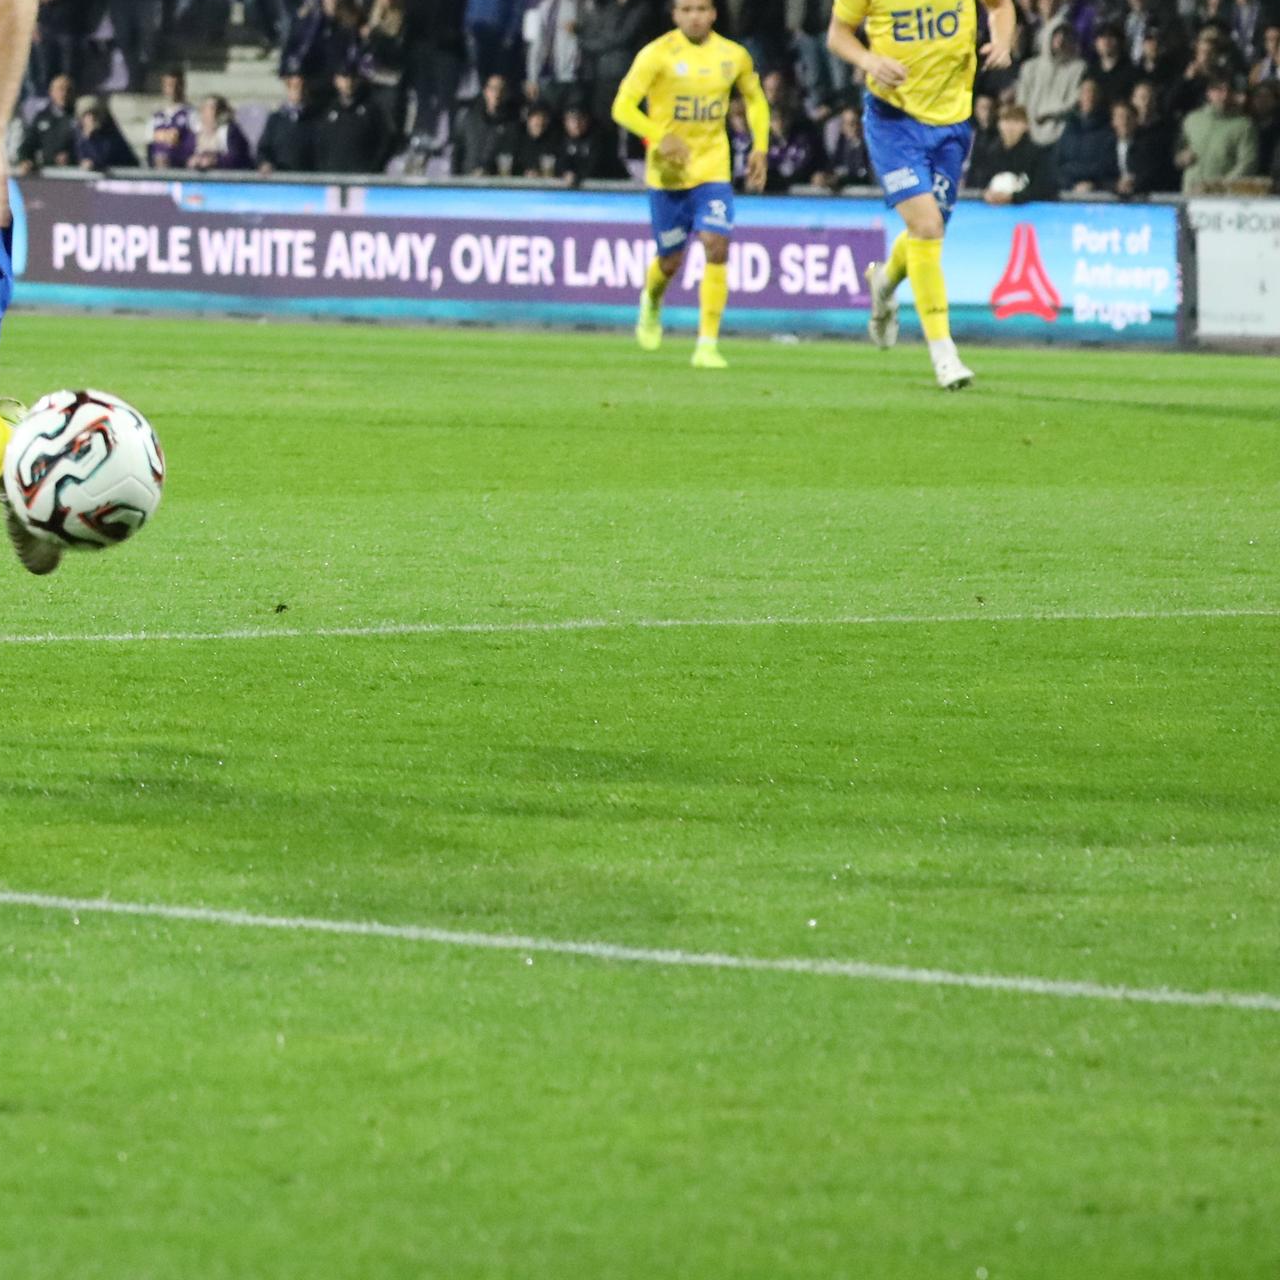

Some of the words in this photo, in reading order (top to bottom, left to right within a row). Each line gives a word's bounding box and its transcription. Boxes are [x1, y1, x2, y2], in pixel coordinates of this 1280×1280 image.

[891, 6, 959, 42] Elio
[1072, 223, 1122, 254] Port
[1125, 223, 1152, 255] of
[52, 222, 191, 274] PURPLE
[198, 226, 317, 278] WHITE
[323, 230, 443, 291] ARMY,
[450, 233, 555, 286] OVER
[779, 243, 861, 295] SEA
[1073, 259, 1170, 295] Antwerp
